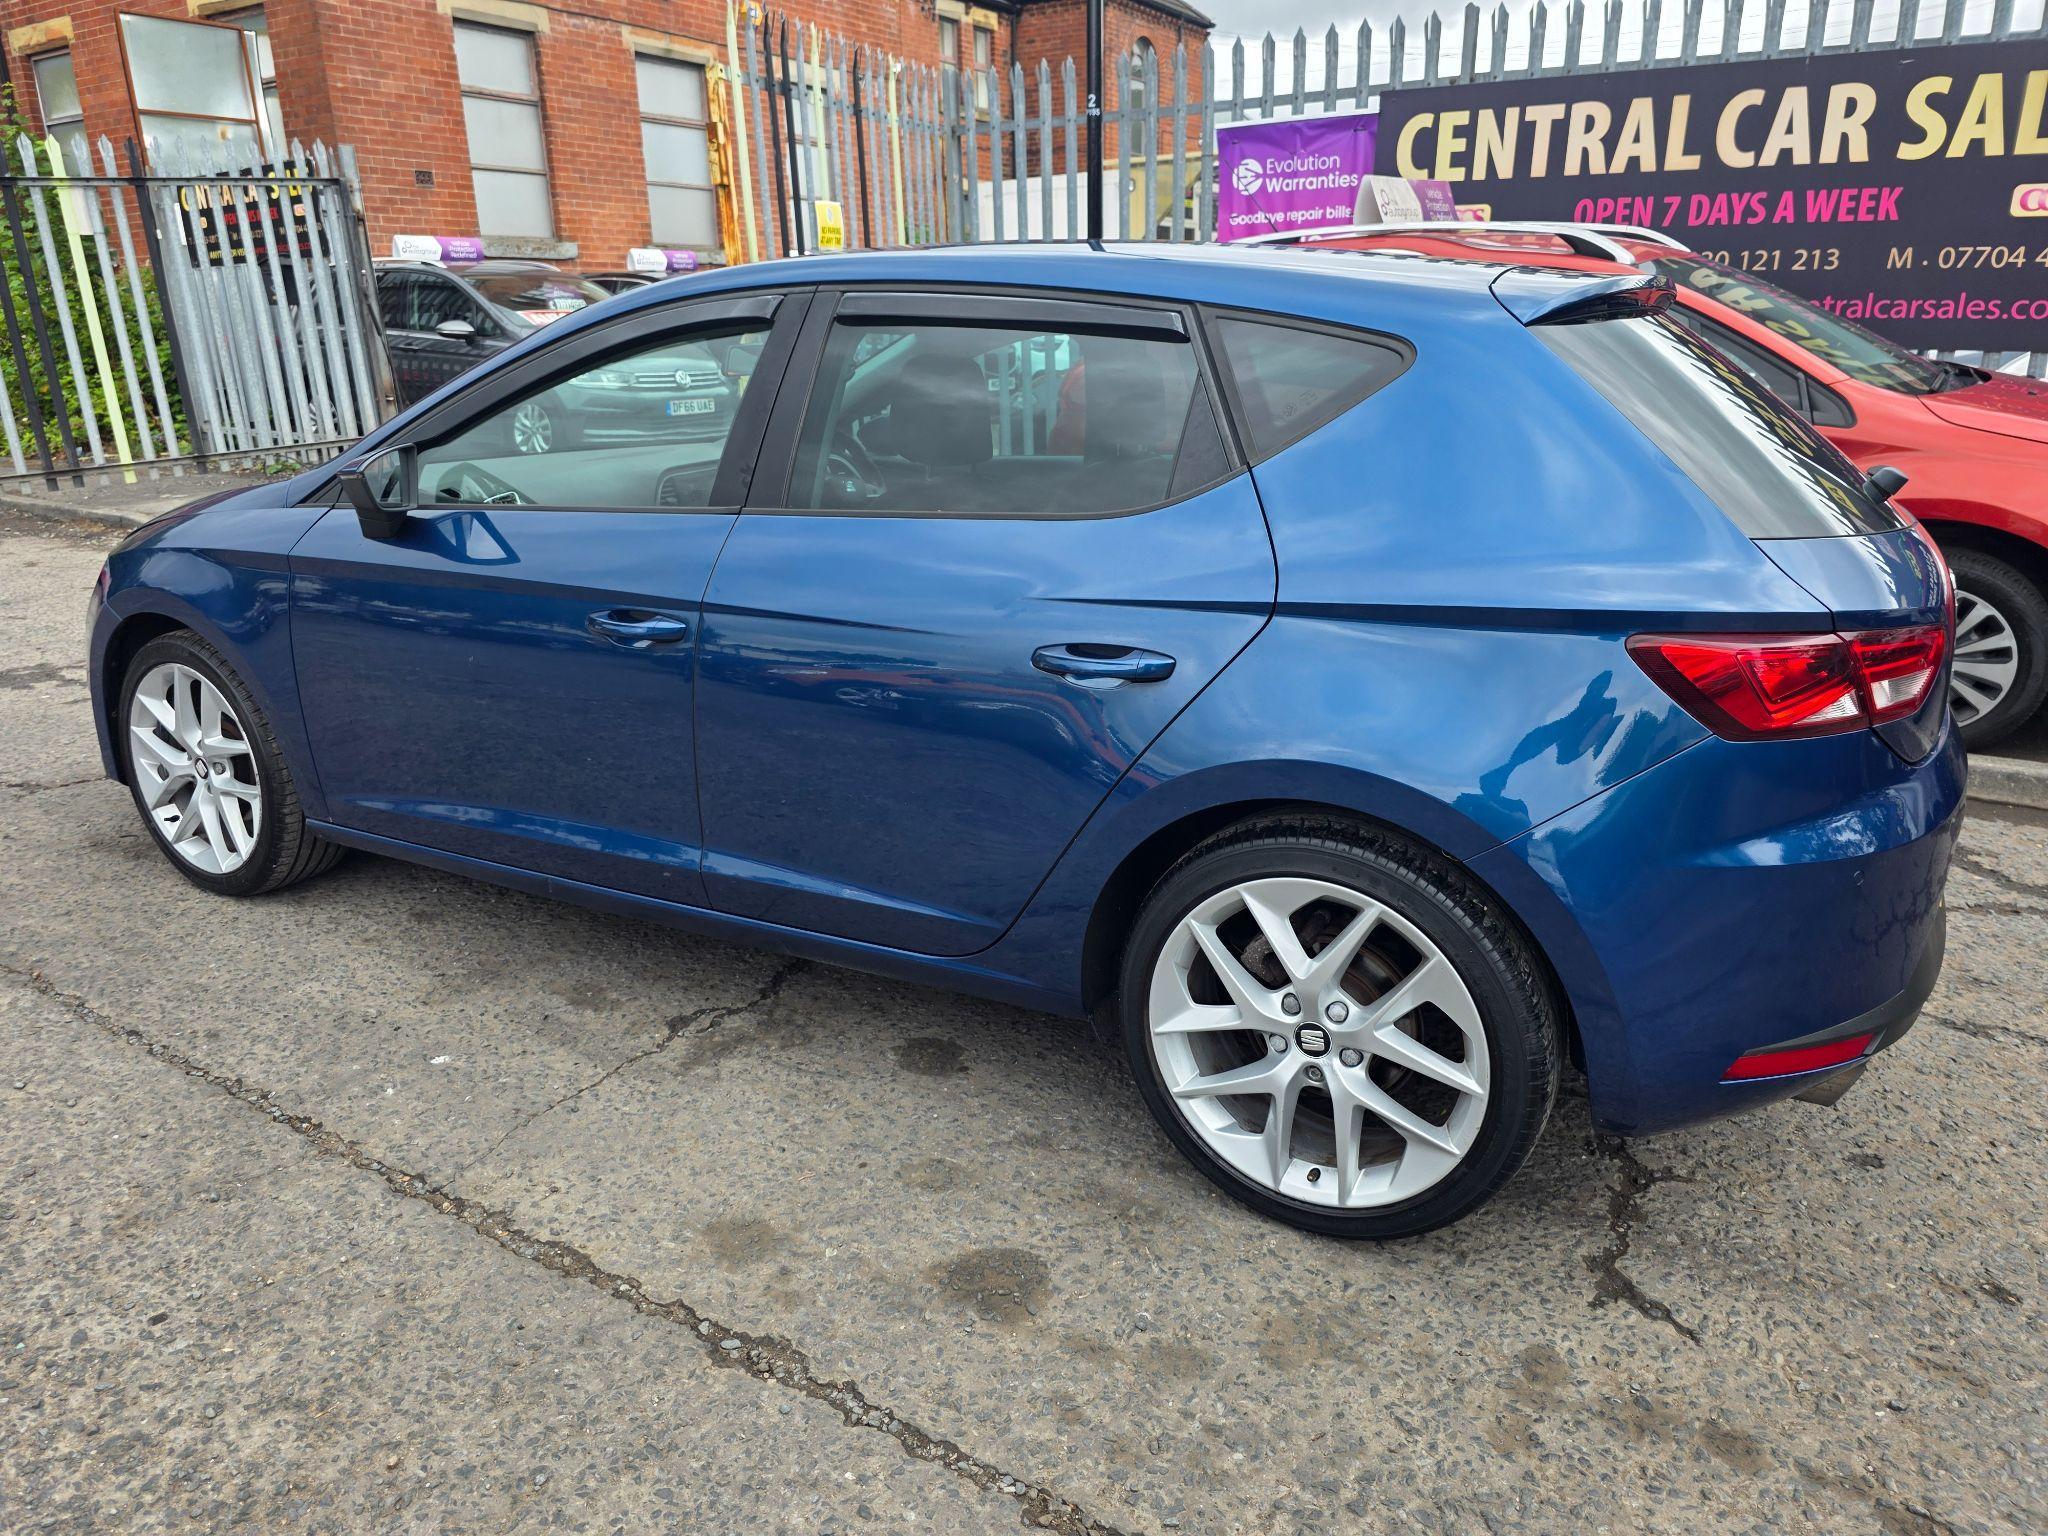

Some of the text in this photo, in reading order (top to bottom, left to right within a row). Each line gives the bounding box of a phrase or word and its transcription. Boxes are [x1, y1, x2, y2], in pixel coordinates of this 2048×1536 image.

[1088, 94, 1096, 108] 2
[1396, 69, 2048, 182] CENTRAL CAR SAL
[1266, 154, 1341, 175] Evolution
[1265, 174, 1359, 193] Warranties
[1229, 211, 1284, 226] Goodbye
[1286, 207, 1324, 224] repair
[1573, 186, 1904, 228] OPEN 7 DAYS A WEEK
[1740, 249, 1781, 271] 121
[1791, 248, 1841, 271] 213
[1887, 247, 1913, 270] M
[1937, 245, 2026, 270] 07704
[697, 399, 714, 411] UAE
